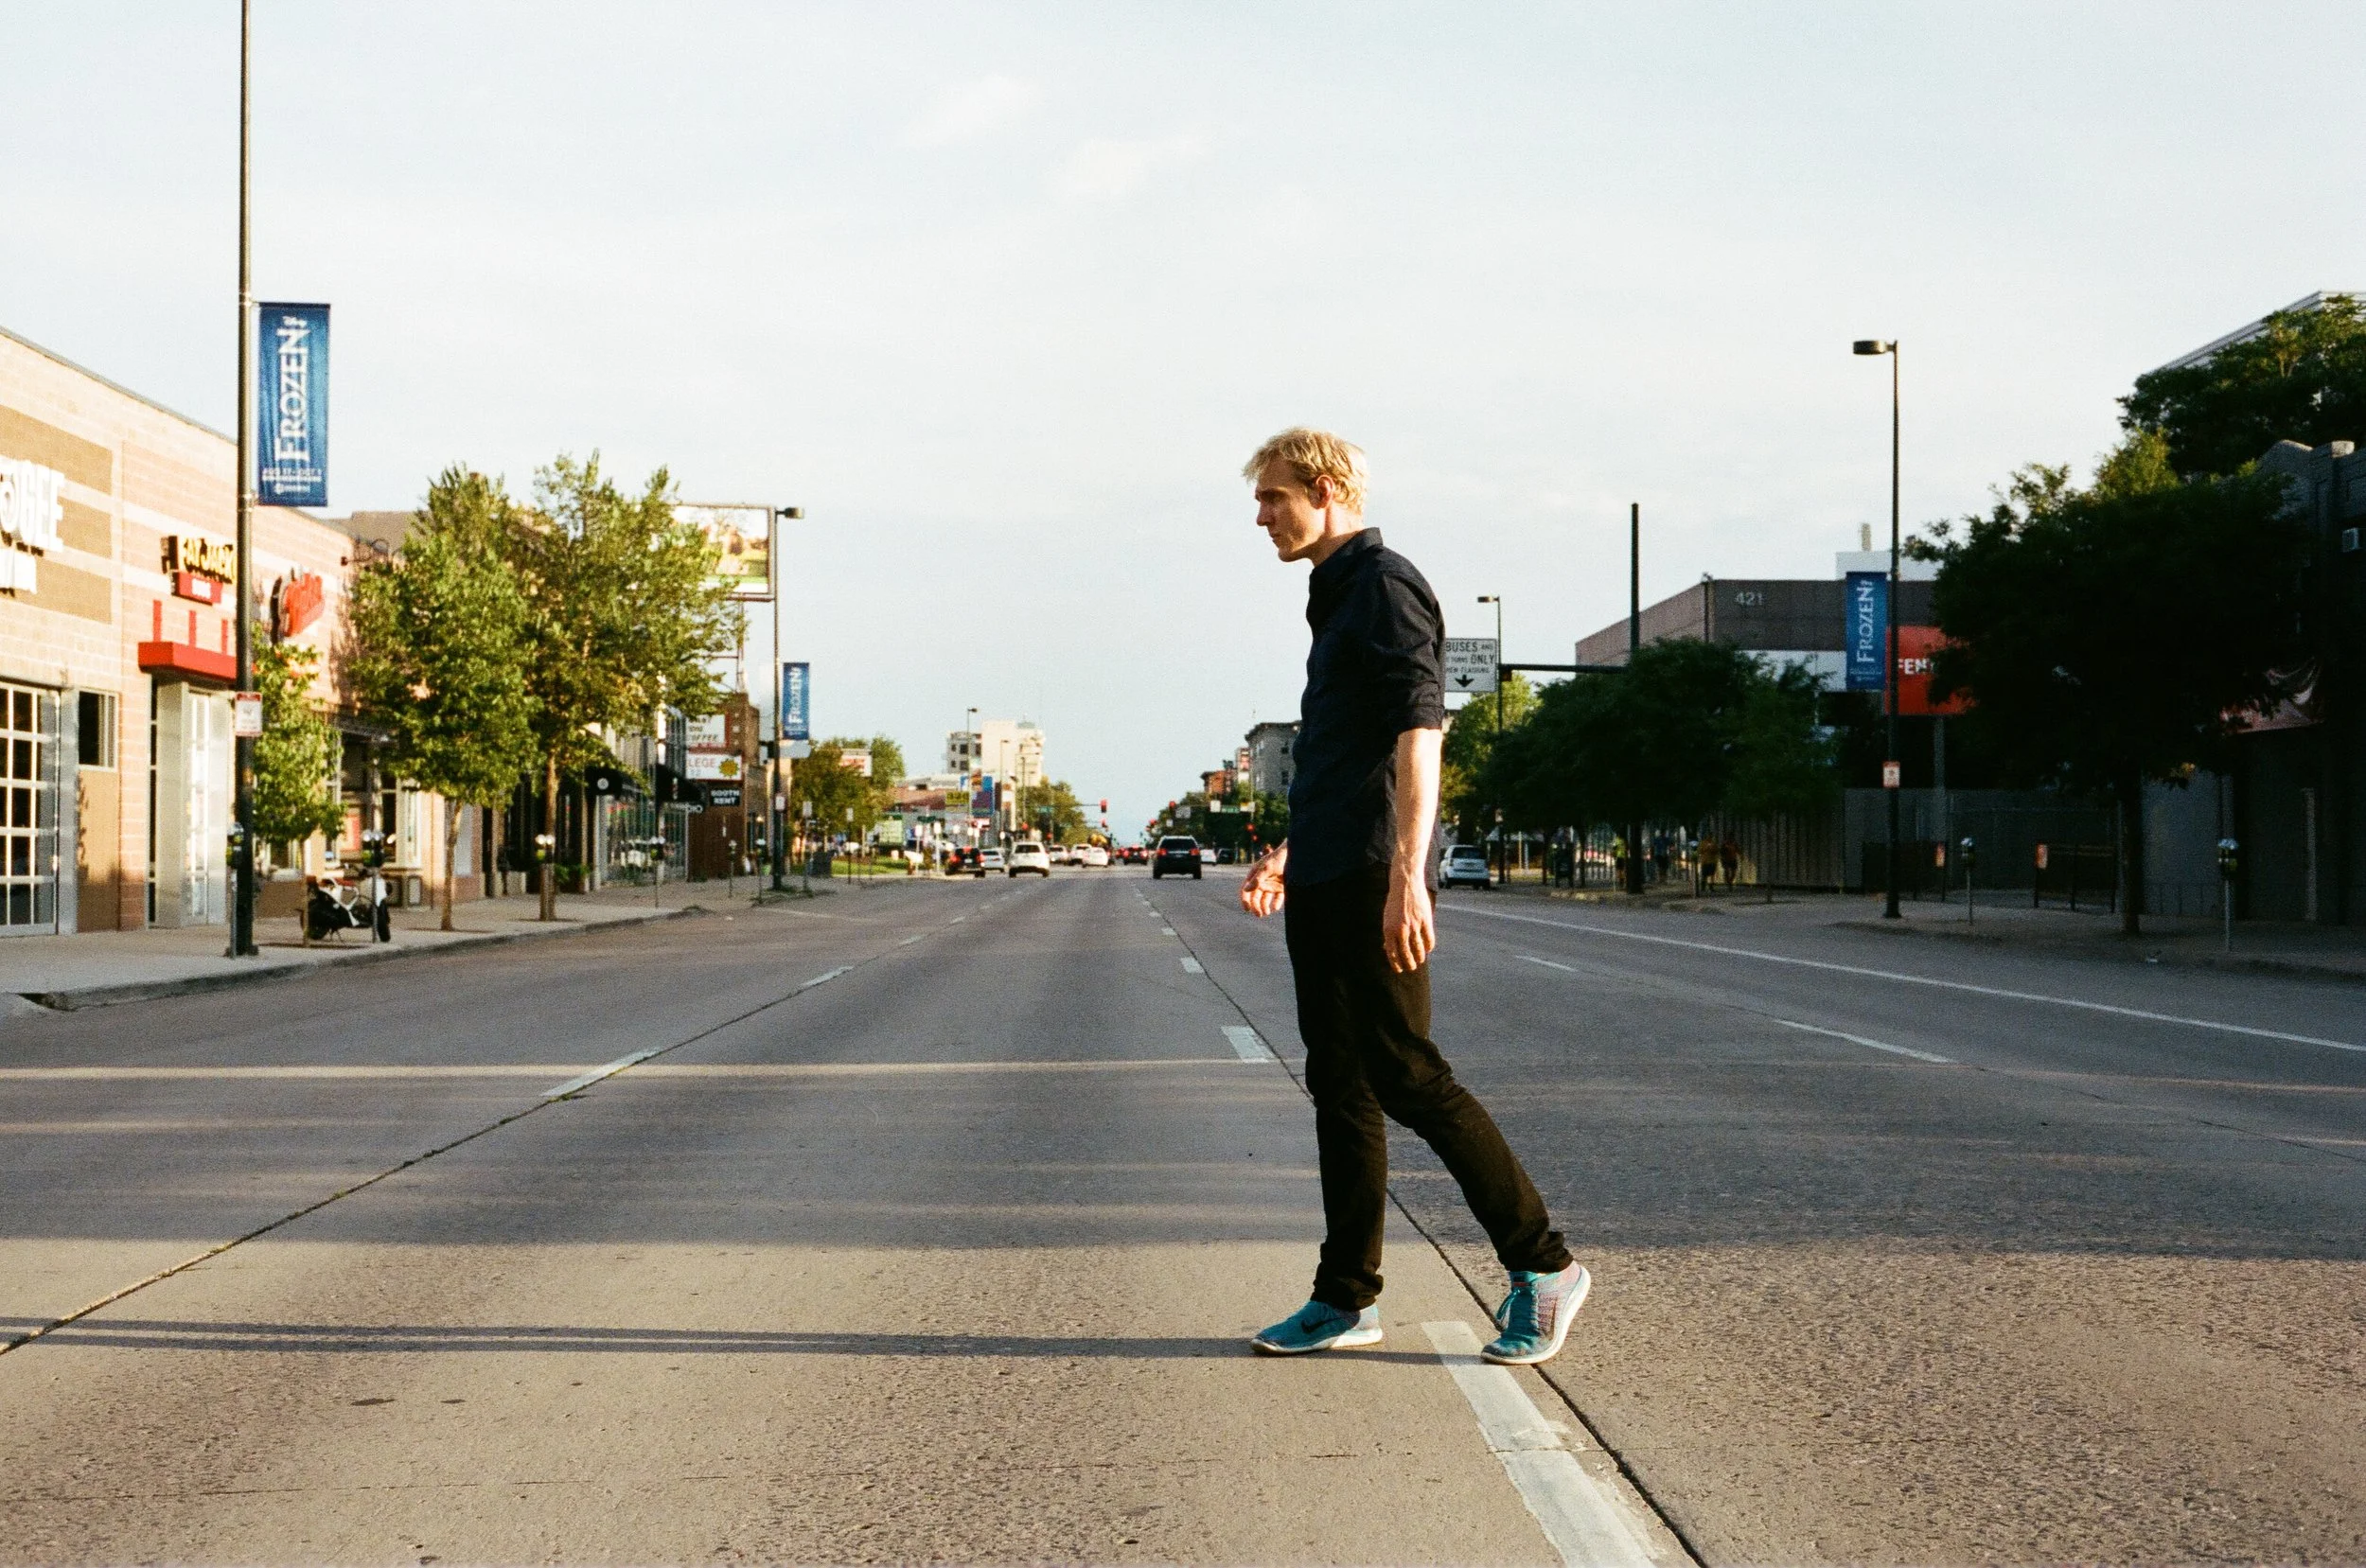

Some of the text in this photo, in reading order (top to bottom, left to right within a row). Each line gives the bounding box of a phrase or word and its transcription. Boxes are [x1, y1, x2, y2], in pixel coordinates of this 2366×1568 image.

[274, 326, 310, 462] FROZEN
[1734, 591, 1763, 606] 421
[1856, 585, 1875, 662] FROZEN
[1471, 654, 1494, 664] ONLY
